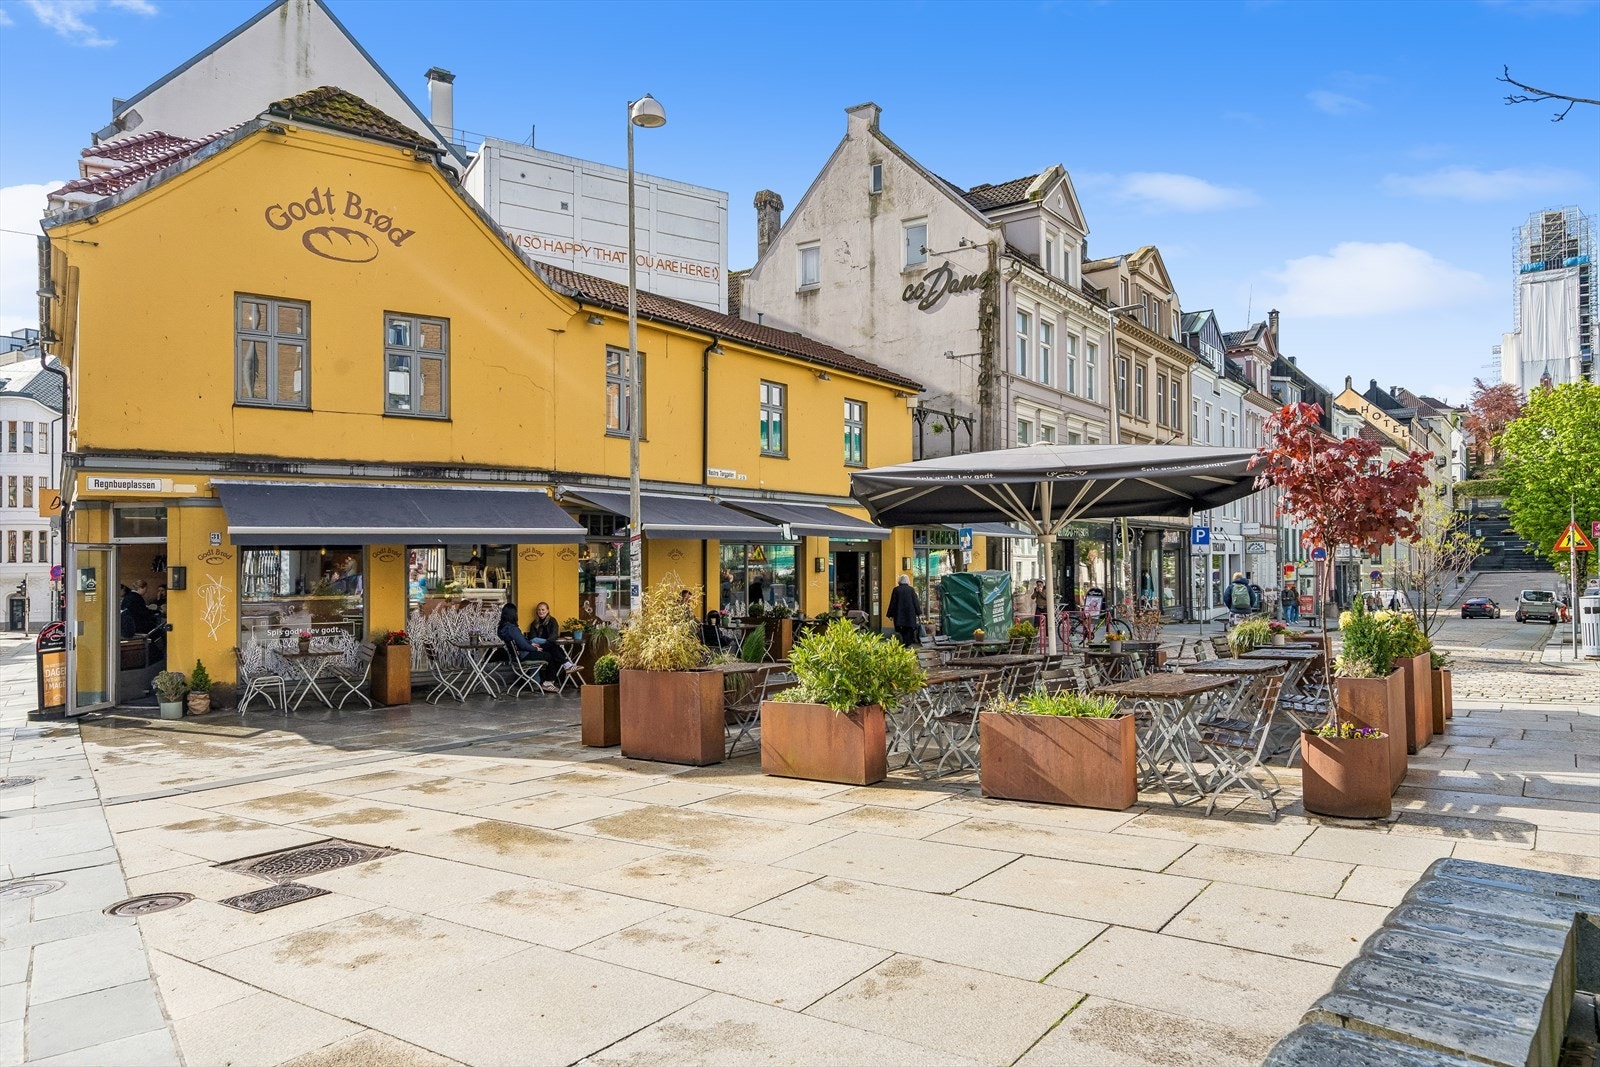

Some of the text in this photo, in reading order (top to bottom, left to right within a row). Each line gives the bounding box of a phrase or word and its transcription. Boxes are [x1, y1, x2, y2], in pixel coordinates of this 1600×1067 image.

[265, 187, 416, 247] Godt Brød
[524, 235, 541, 249] SO
[543, 240, 591, 257] HAPPY
[594, 247, 627, 263] THAT
[636, 255, 654, 267] OU
[656, 258, 678, 272] ARE
[680, 262, 710, 277] HERE
[1361, 405, 1408, 438] HOTEL
[94, 479, 156, 490] Regnbueplassen
[1196, 530, 1206, 542] P
[198, 549, 214, 560] Godt
[267, 629, 283, 637] Spis
[321, 627, 341, 635] godt.
